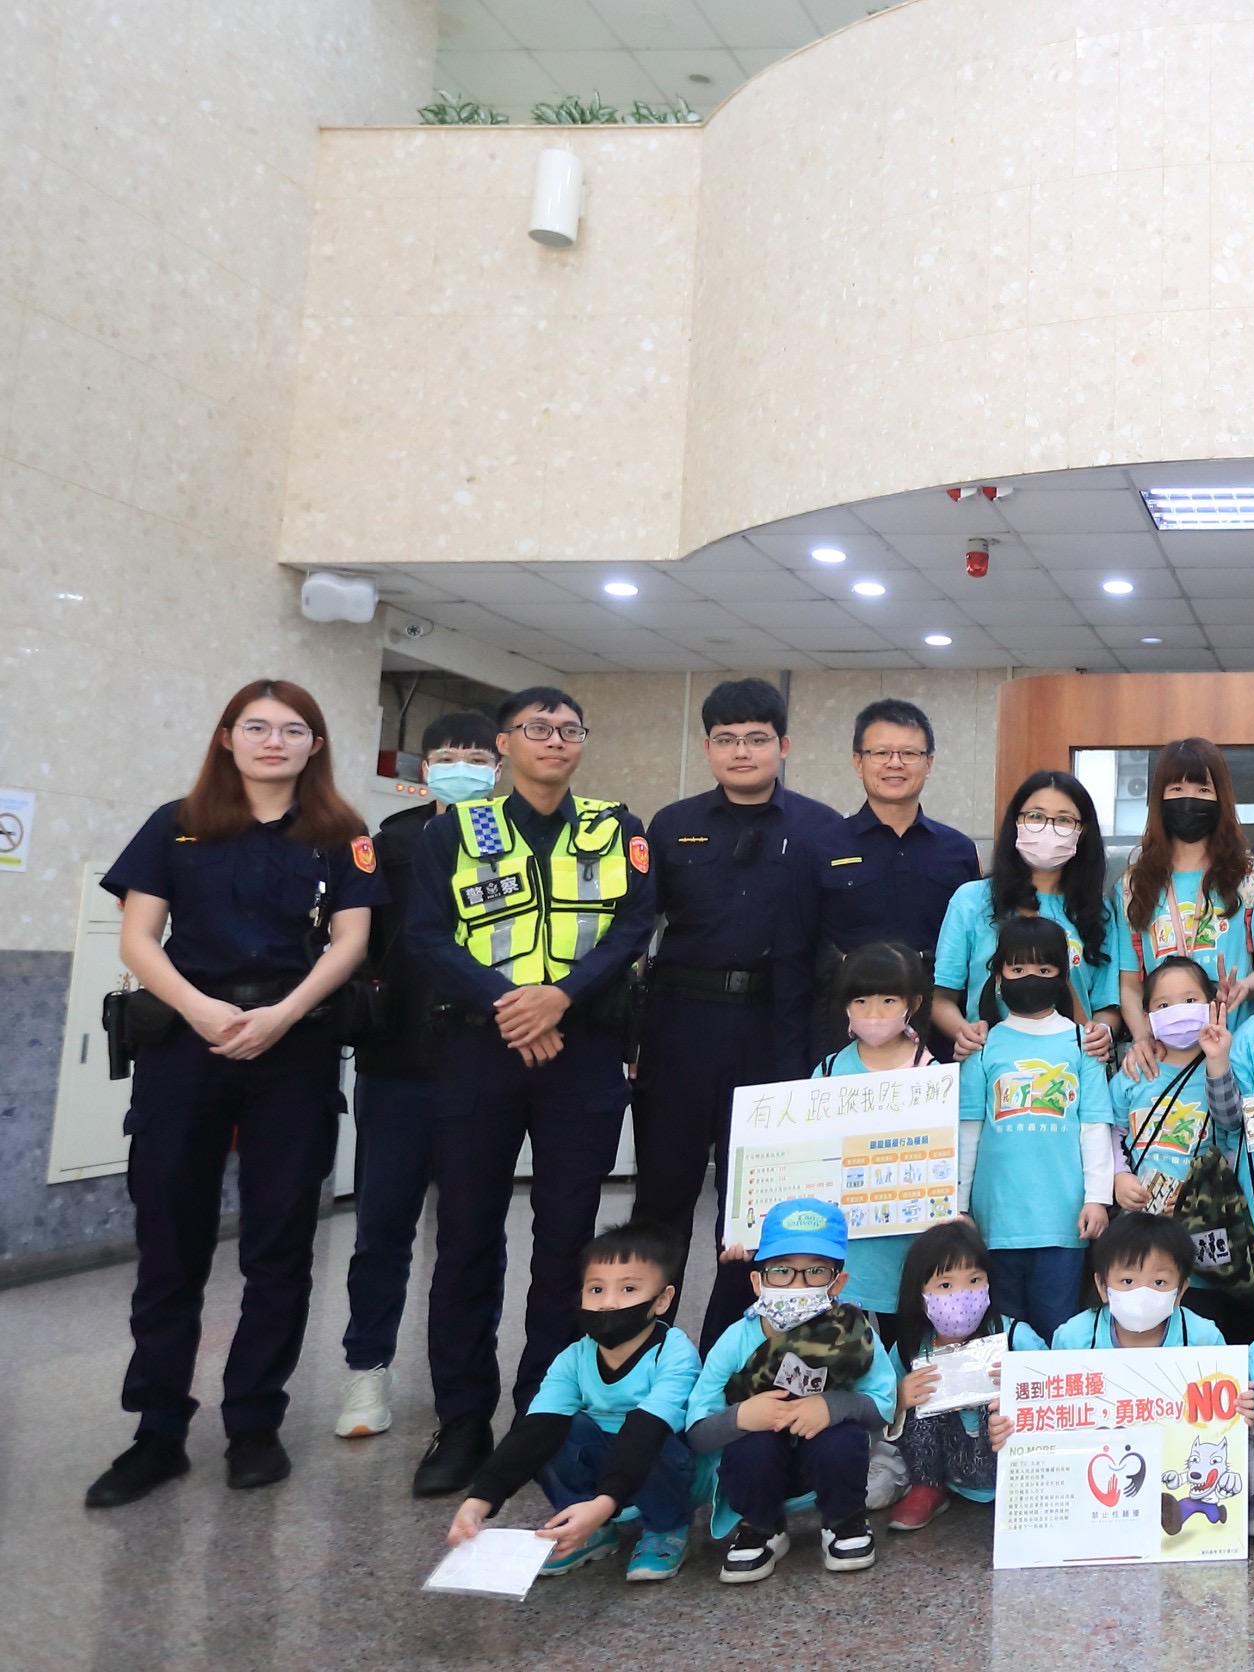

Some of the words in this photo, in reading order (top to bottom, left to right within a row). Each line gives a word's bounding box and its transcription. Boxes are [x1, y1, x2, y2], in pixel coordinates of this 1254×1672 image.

[465, 885, 484, 905] 警
[500, 876, 519, 895] 察
[1016, 1372, 1105, 1400] 遇到性騷擾
[1187, 1379, 1239, 1424] NO
[1009, 1446, 1025, 1456] NO
